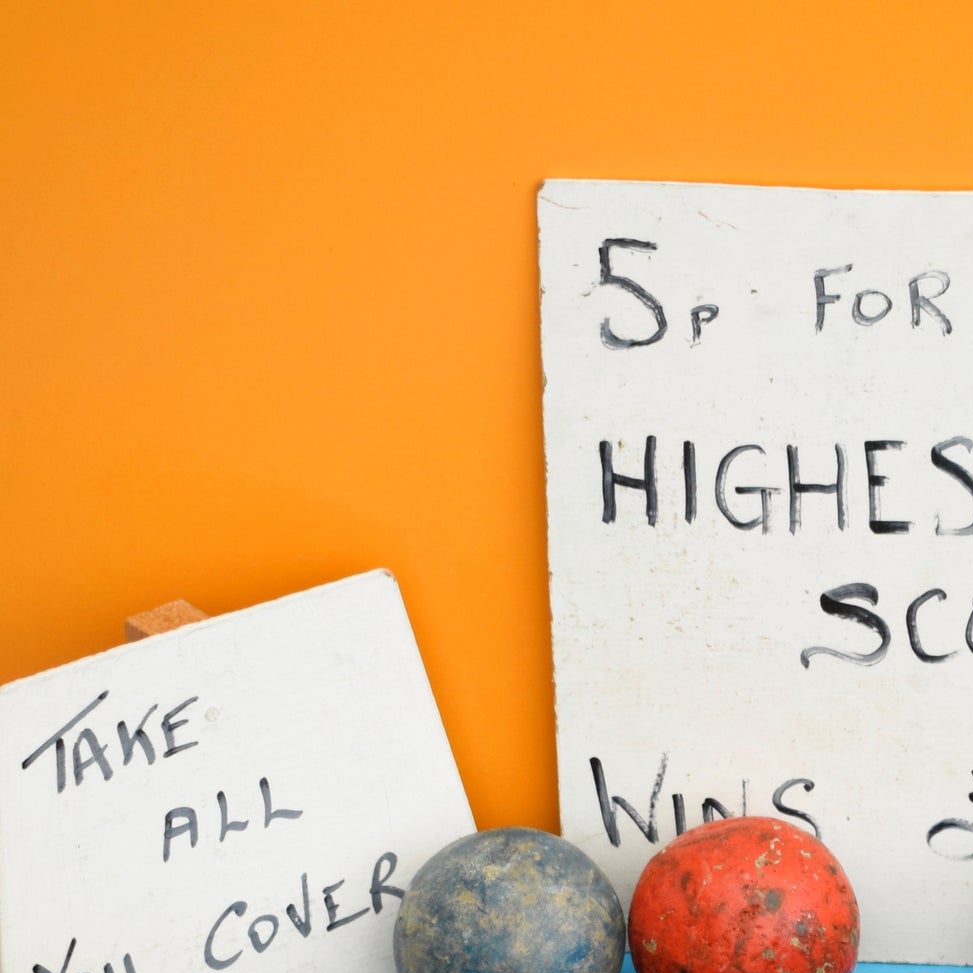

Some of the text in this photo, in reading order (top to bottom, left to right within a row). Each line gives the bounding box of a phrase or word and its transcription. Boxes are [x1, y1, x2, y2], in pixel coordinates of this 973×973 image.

[813, 264, 953, 335] FOR
[21, 690, 199, 794] TAKE
[162, 777, 303, 863] ALL
[203, 851, 406, 971] COVER
